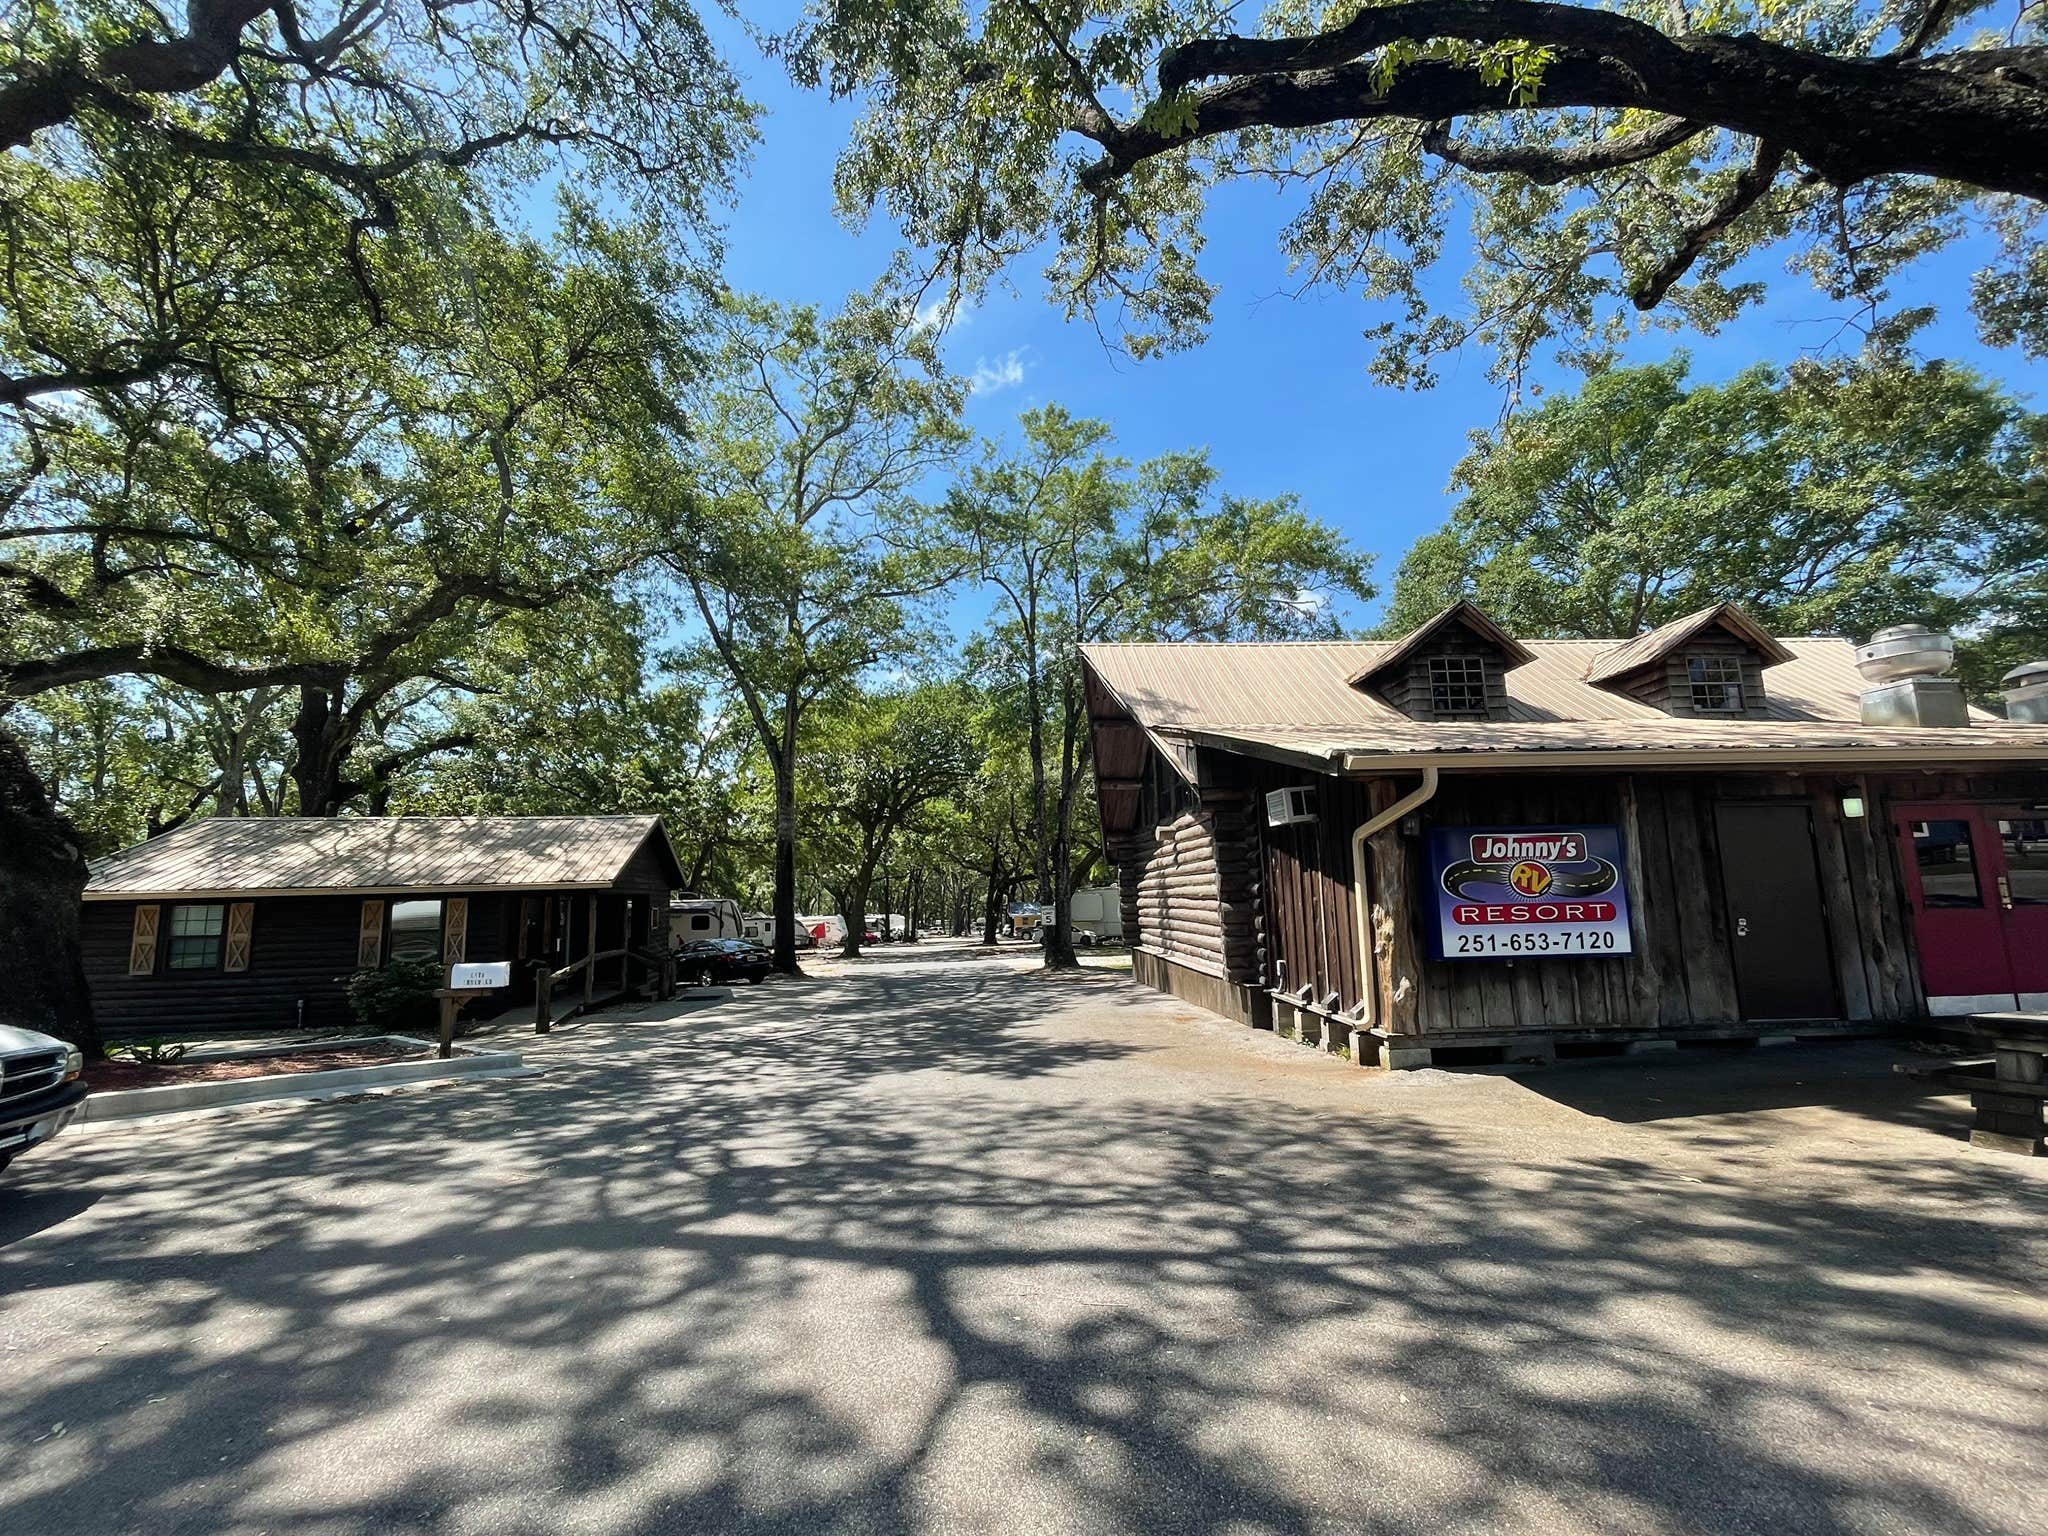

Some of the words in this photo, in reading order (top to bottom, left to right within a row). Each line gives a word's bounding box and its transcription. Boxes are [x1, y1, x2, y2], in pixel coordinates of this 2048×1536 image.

[1481, 836, 1576, 860] Johnny's
[1512, 864, 1551, 893] RV
[1461, 904, 1607, 921] RESORT
[1458, 932, 1614, 953] 251-653-7120
